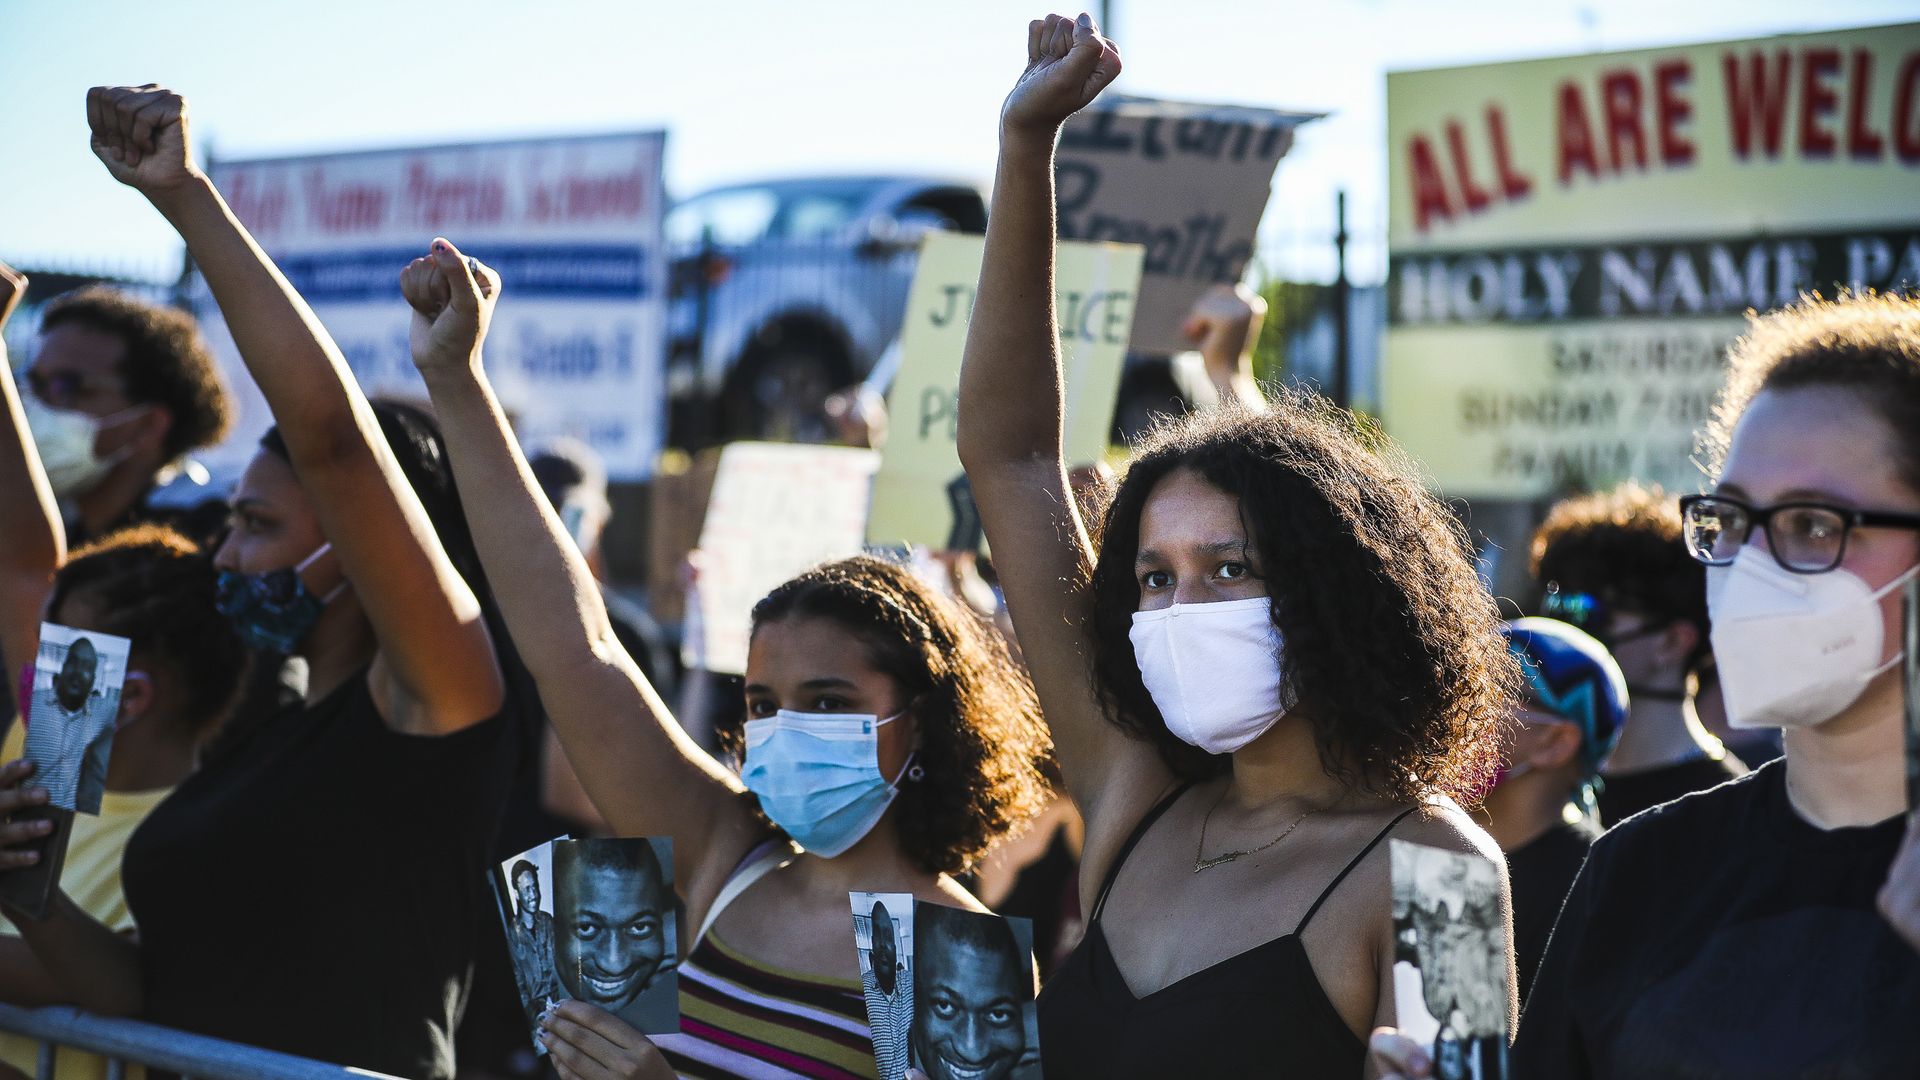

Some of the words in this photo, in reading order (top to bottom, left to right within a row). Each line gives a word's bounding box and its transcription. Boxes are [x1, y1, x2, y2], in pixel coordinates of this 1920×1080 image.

[1406, 103, 1536, 236] ALL
[1555, 57, 1698, 187] ARE
[1402, 250, 1582, 322] HOLY
[1598, 240, 1816, 318] NAME
[1549, 336, 1730, 376] SATURDA
